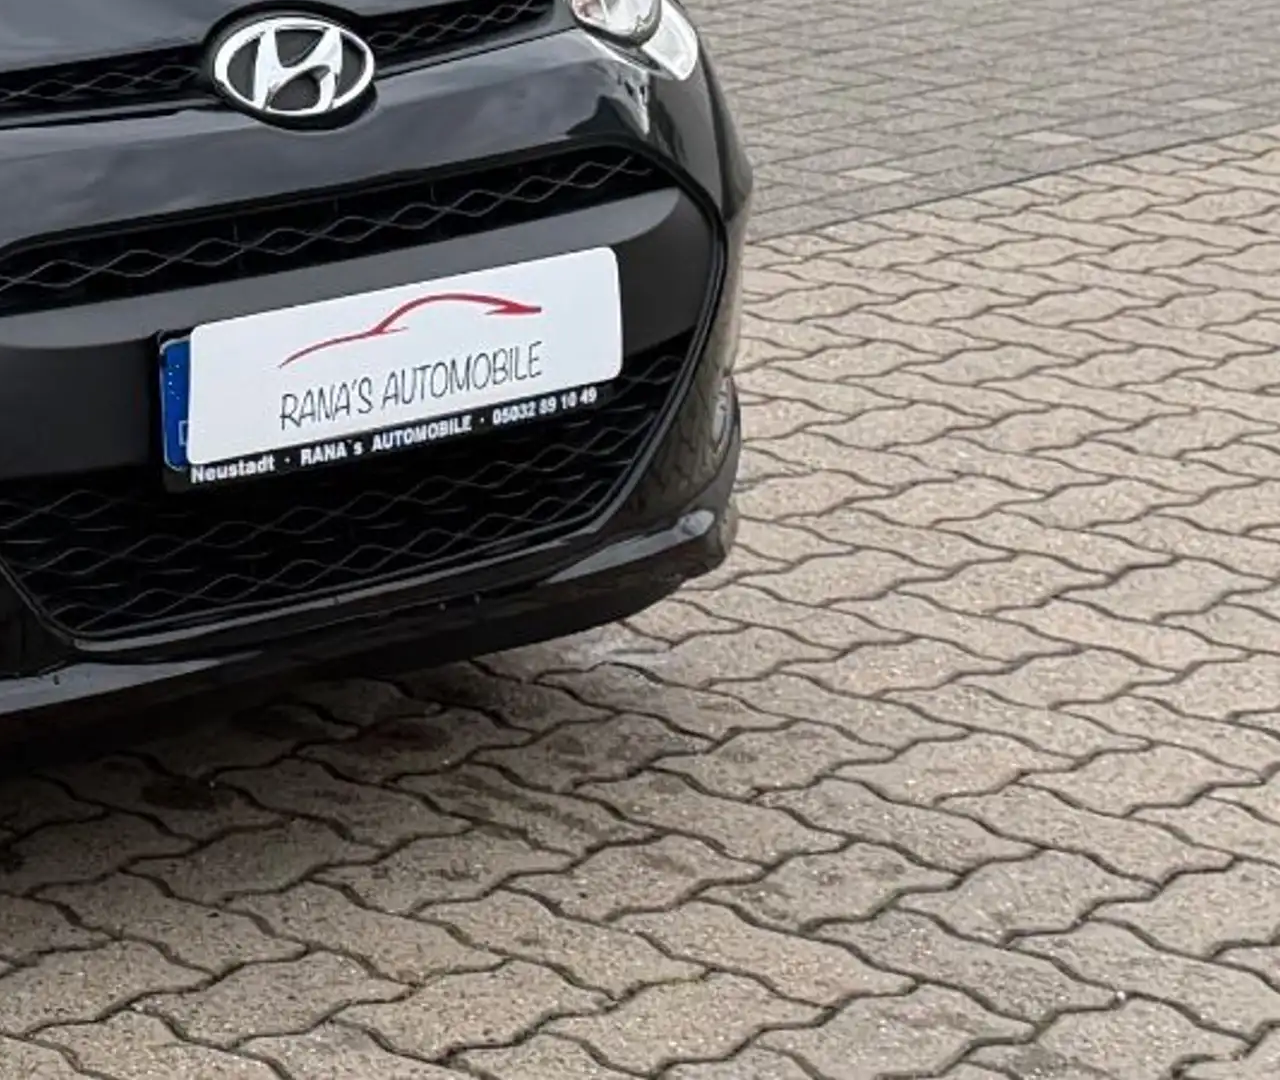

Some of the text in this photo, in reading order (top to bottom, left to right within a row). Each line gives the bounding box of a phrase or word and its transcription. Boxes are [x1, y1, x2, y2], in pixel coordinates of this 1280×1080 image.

[279, 341, 543, 430] RANA'S AUTOMOBILE
[191, 454, 275, 483] Neustadt
[371, 415, 473, 452] AUTOMOBILE
[492, 401, 537, 426] 05032
[560, 391, 578, 409] 10
[579, 386, 598, 405] 49
